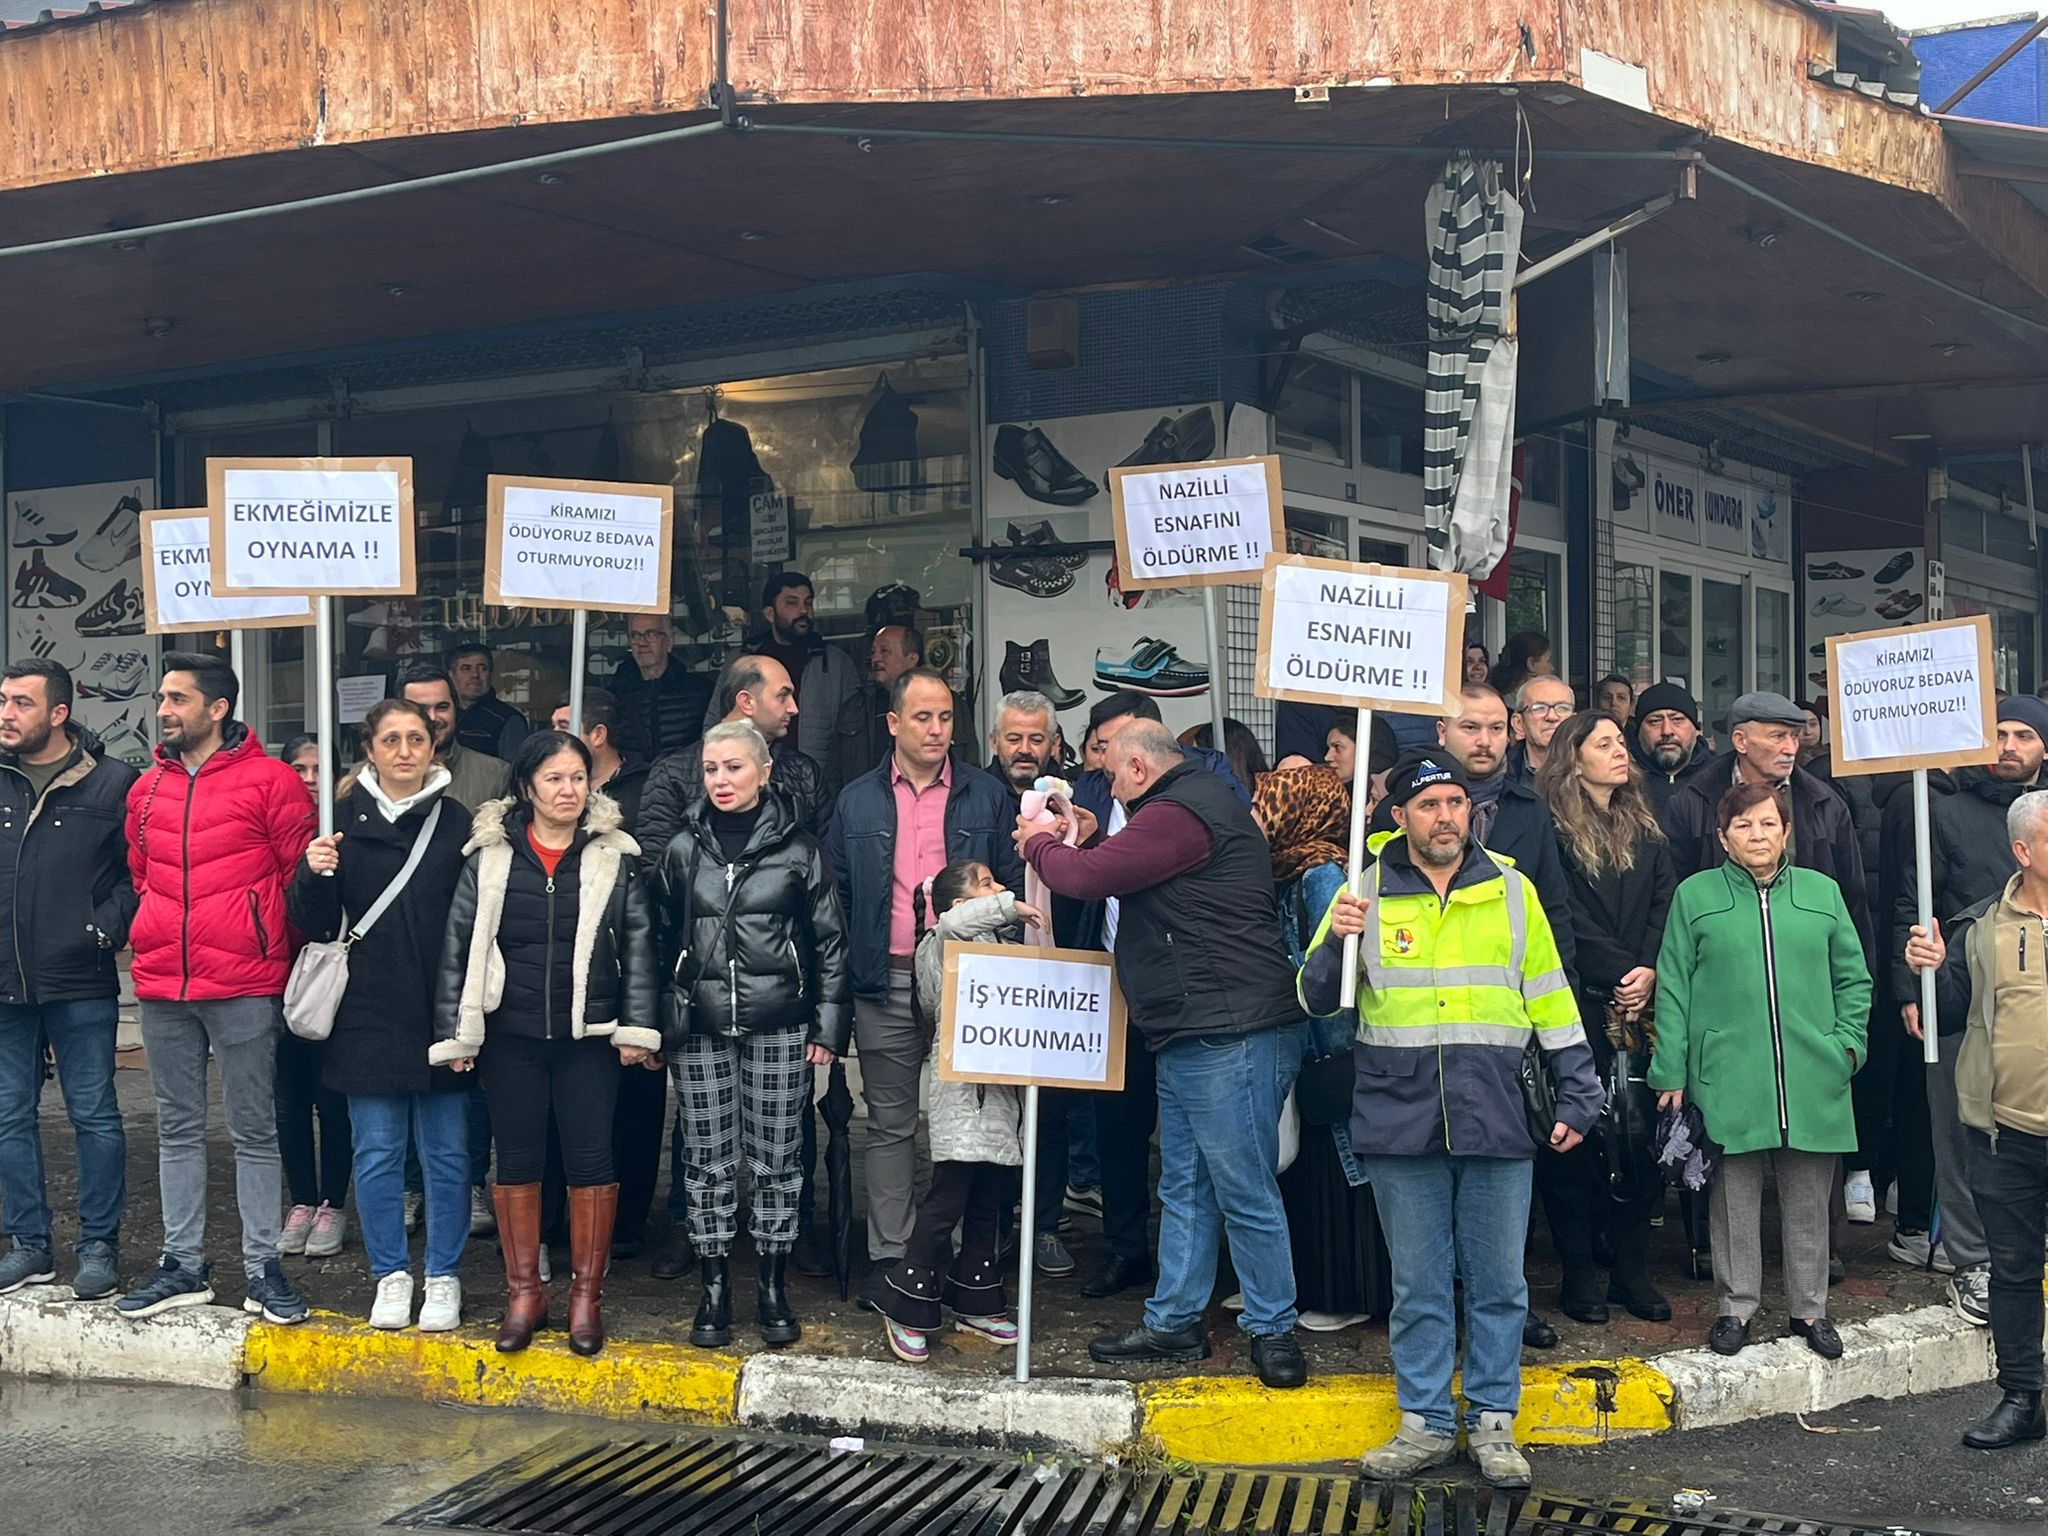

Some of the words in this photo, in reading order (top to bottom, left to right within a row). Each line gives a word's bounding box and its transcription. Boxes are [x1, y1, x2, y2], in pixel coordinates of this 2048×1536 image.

[1159, 474, 1230, 500] NAZİLLİ
[1655, 472, 1695, 524] ÖNER
[234, 499, 392, 523] EKMEĞİMİZLE
[550, 503, 616, 521] KİRAMIZI
[1154, 511, 1241, 533] ESNAFINI
[509, 522, 592, 543] ÖDÜYORUZ
[596, 532, 655, 547] BEDAVA
[248, 541, 356, 559] OYNAMA
[365, 541, 378, 559] !!
[517, 551, 644, 570] OTURMUYORUZ!!
[1143, 544, 1239, 567] ÖLDÜRME
[1246, 541, 1259, 559] !!
[1320, 583, 1403, 610] NAZİLLİ
[1307, 621, 1411, 650] ESNAFINI
[1876, 647, 1934, 667] KİRAMIZI
[1287, 653, 1403, 687] ÖLDÜRME
[1413, 670, 1427, 690] !!
[1844, 676, 1915, 697] ÖDÜYORUZ
[1919, 669, 1974, 688] BEDAVA
[1852, 696, 1966, 723] OTURMUYORUZ!!
[970, 979, 989, 1010] İŞ
[997, 983, 1100, 1013] YERİMİZE
[961, 1024, 1102, 1055] DOKUNMA!!
